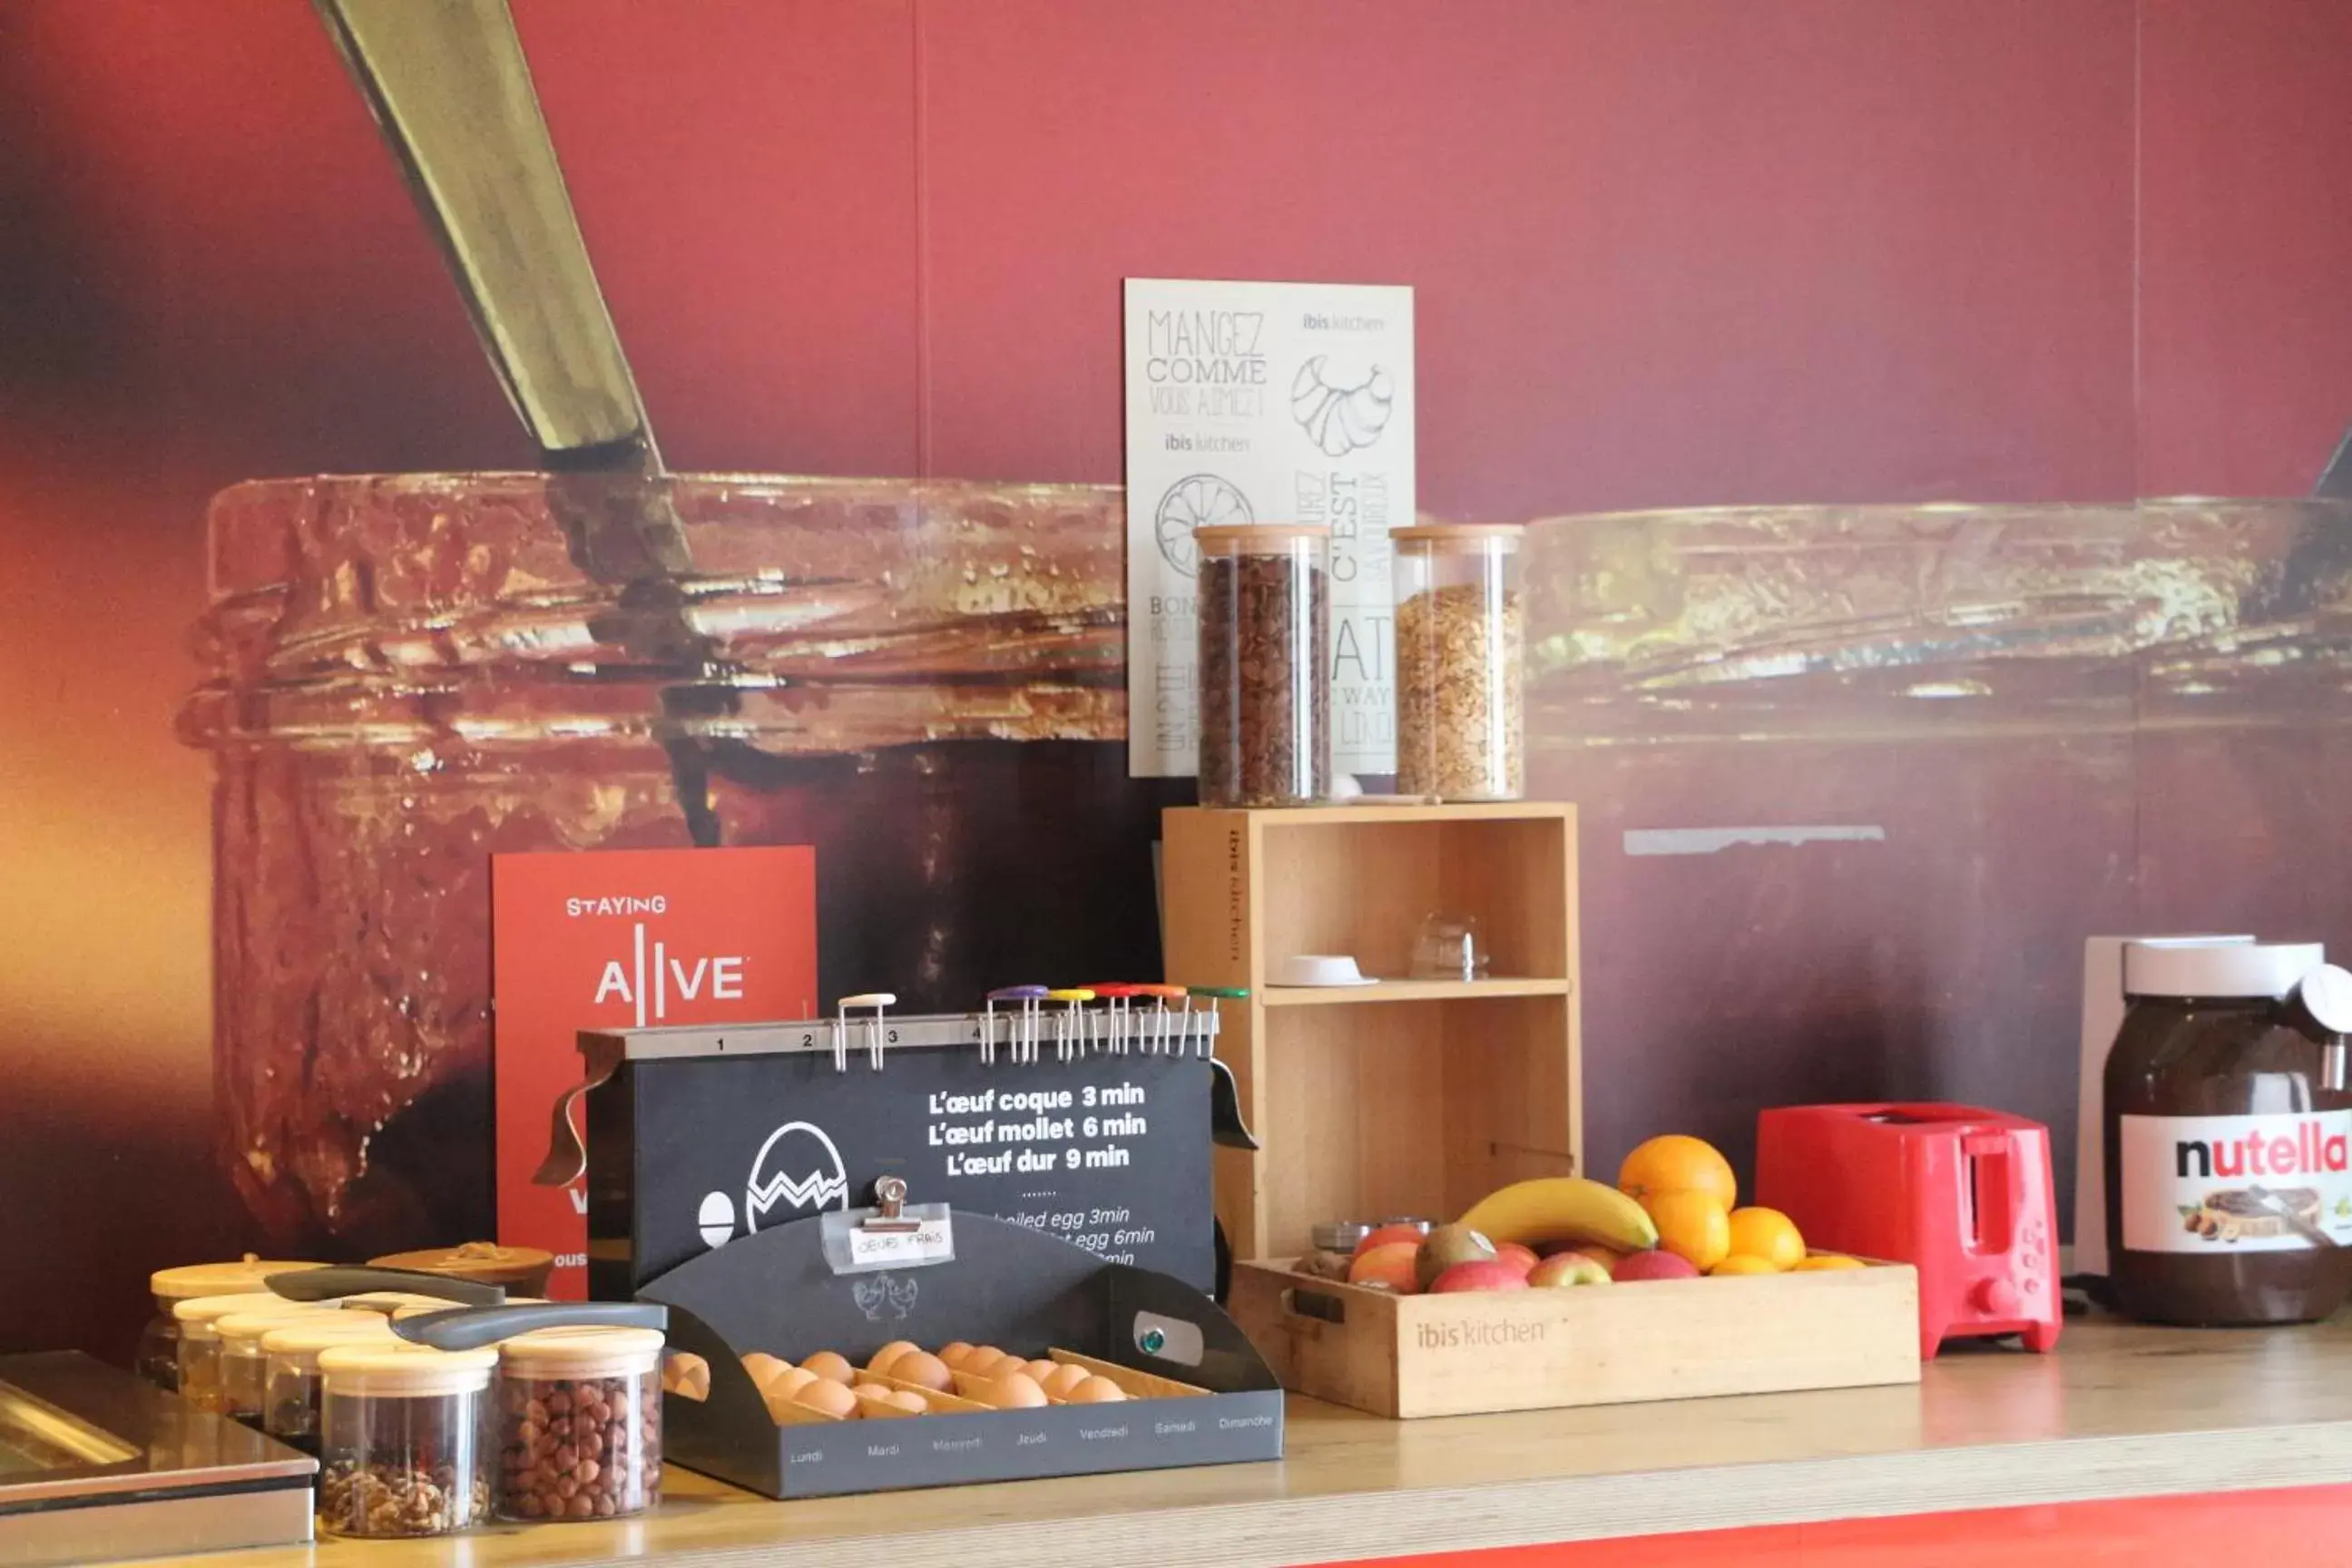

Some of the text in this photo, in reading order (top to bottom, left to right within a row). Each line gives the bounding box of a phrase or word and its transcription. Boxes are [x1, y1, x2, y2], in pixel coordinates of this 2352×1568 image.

[1148, 309, 1264, 356] MANGEZ
[1303, 313, 1384, 331] ibis kitchen
[1146, 358, 1267, 384] COMME
[1165, 434, 1250, 452] ibis kitchen
[1330, 471, 1357, 582] C'EST
[566, 895, 666, 916] STAYING
[717, 1036, 725, 1052] 1
[802, 1034, 813, 1048] 2
[888, 1029, 898, 1044] 3
[999, 1090, 1073, 1114] coque
[1082, 1085, 1097, 1107] 3
[1102, 1082, 1146, 1106] min
[998, 1118, 1075, 1141] mollet
[1083, 1116, 1099, 1138] 6
[1103, 1113, 1147, 1136] min
[1016, 1149, 1057, 1172] dur
[1065, 1148, 1081, 1170] 9
[1085, 1144, 1130, 1168] min
[2176, 1119, 2347, 1178] nutella
[1051, 1211, 1084, 1230] egg
[1089, 1206, 1131, 1225] 3min
[1075, 1232, 1110, 1251] egg
[1113, 1227, 1155, 1246] 6min
[1416, 1318, 1544, 1348] ibis kitchen
[1016, 1432, 1047, 1446] Jeudi
